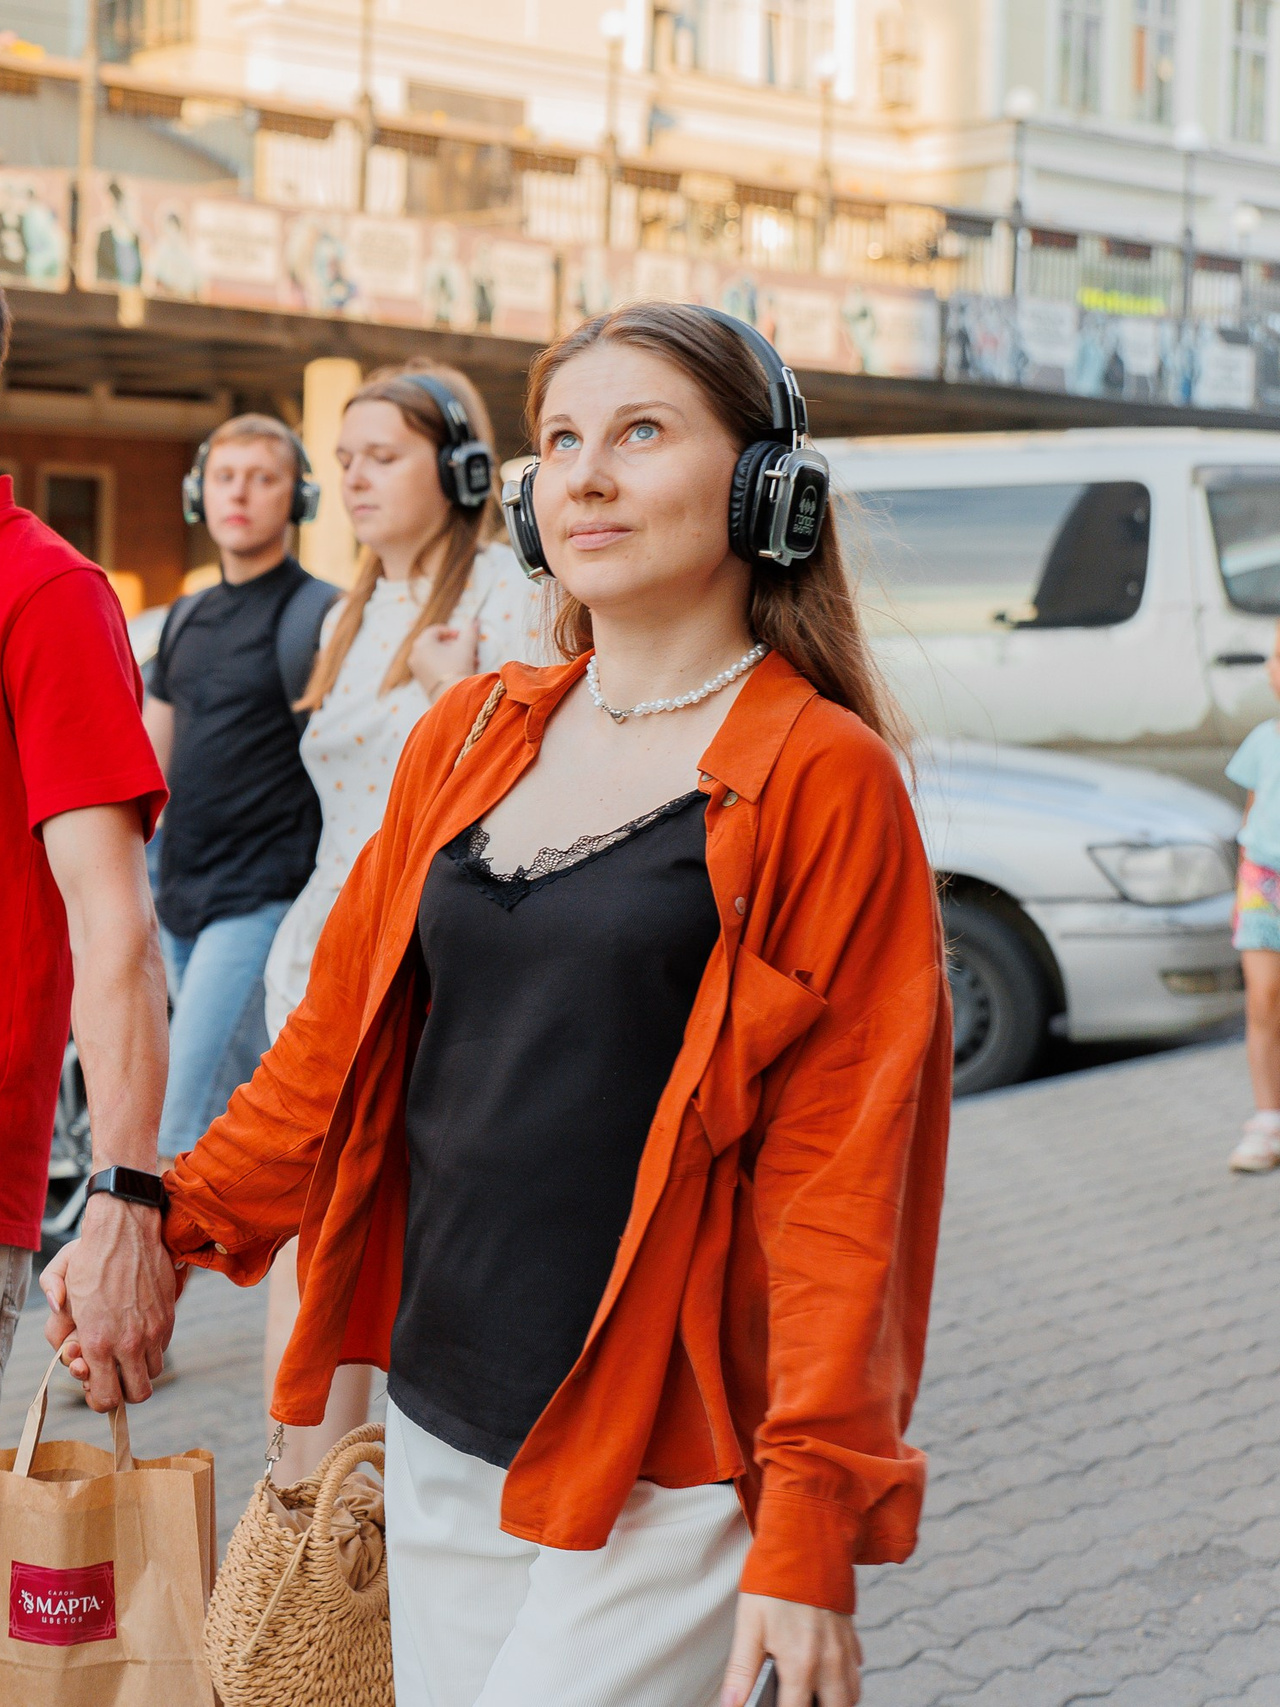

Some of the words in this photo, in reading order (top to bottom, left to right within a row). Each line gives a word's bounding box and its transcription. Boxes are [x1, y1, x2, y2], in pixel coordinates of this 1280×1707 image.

[48, 1589, 75, 1597] САЛОН
[36, 1595, 101, 1616] МАРТА
[41, 1616, 84, 1626] ЦВЕТОВ
